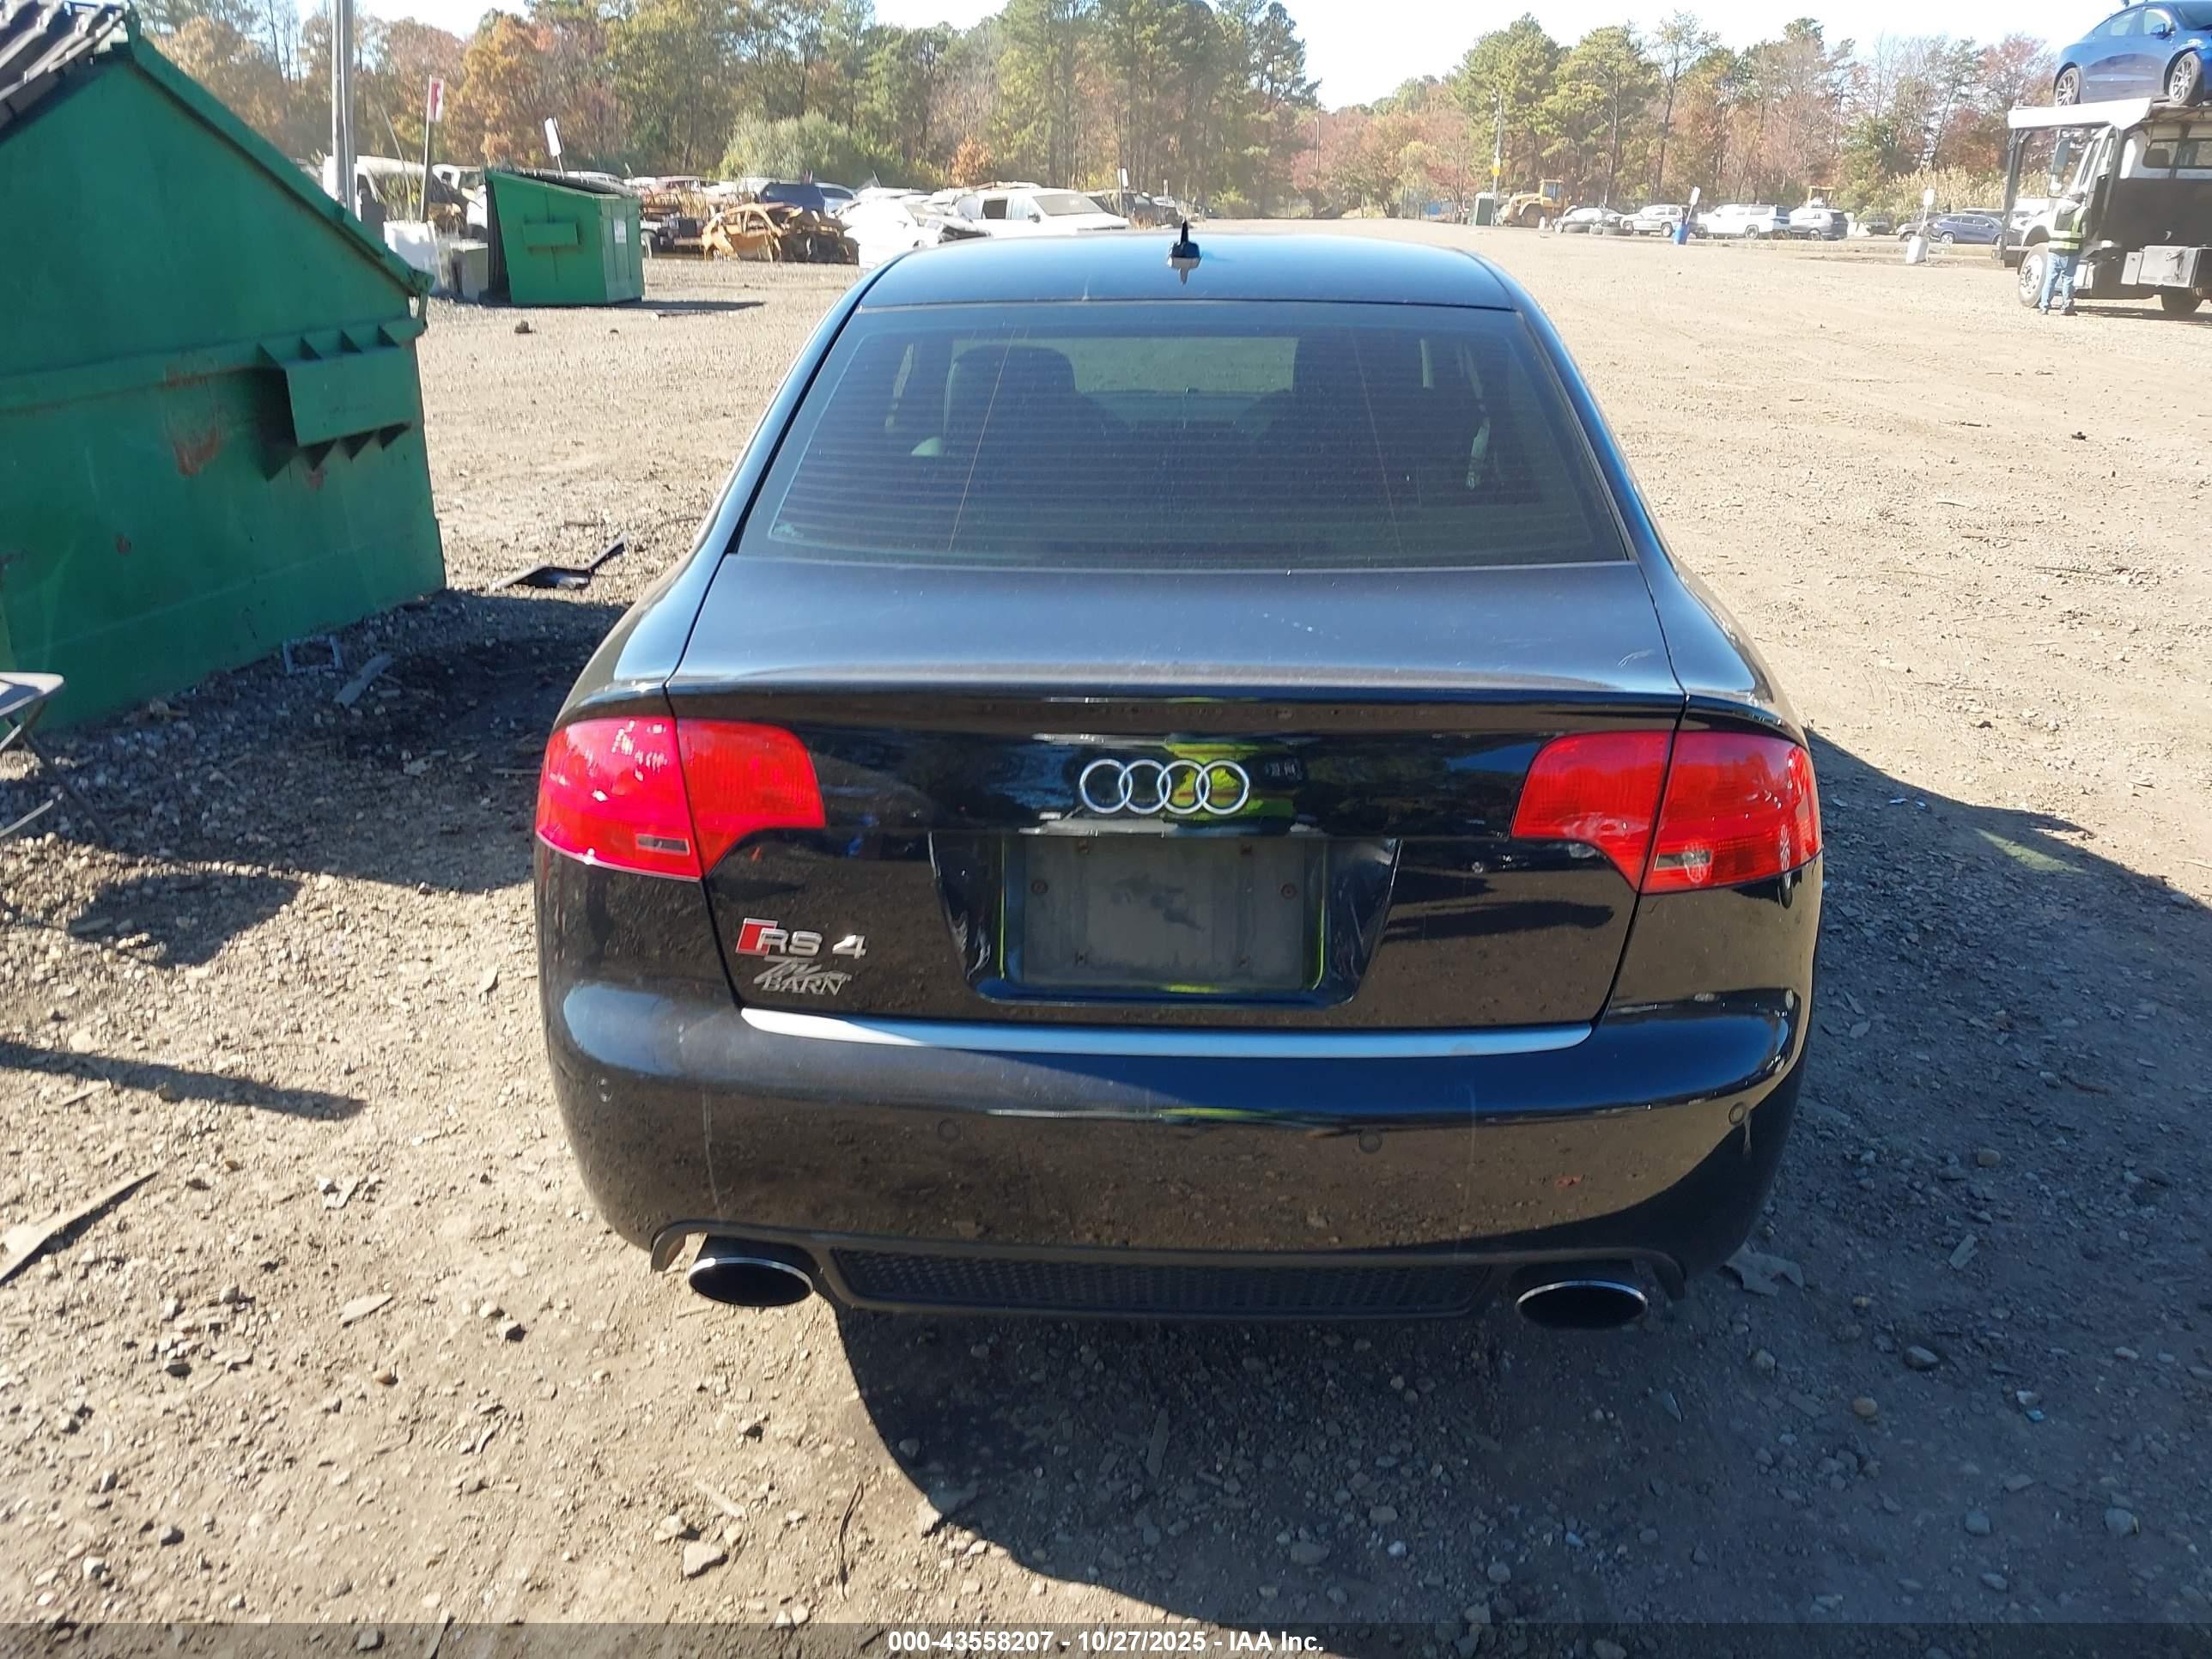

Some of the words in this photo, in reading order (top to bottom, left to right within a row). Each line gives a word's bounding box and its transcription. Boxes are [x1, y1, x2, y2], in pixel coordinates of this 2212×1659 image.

[755, 927, 823, 956] RS
[832, 934, 866, 959] 4
[762, 975, 843, 995] BARN
